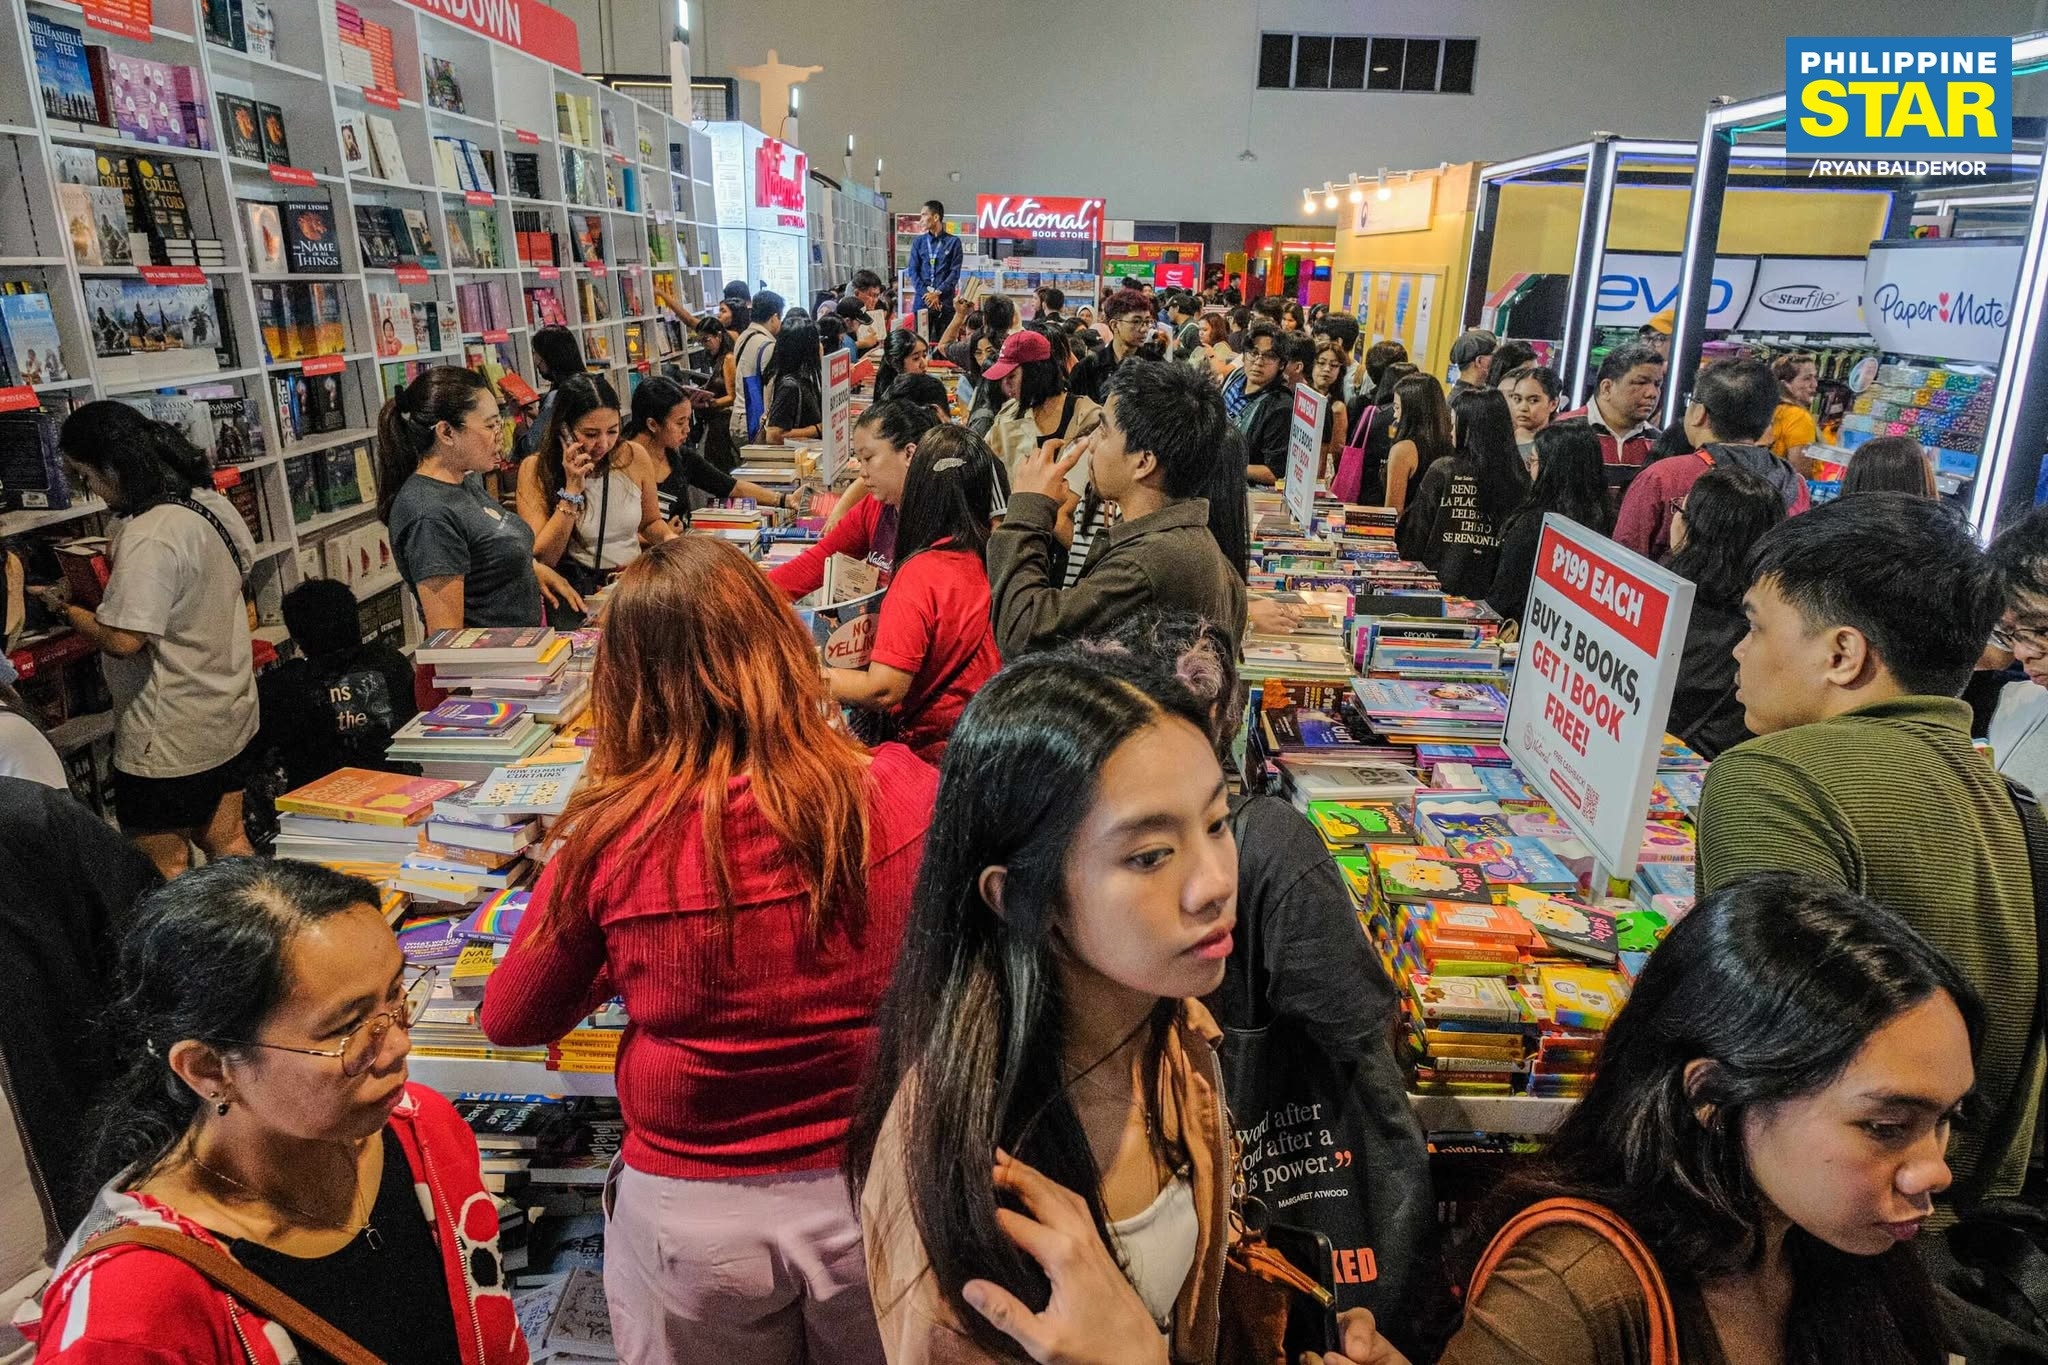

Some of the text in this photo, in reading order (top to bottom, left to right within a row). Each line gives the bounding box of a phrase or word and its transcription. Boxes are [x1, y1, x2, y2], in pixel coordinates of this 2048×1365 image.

[48, 30, 83, 47] ANIELLE
[980, 197, 1093, 229] National
[1061, 231, 1090, 239] STORE
[1874, 283, 2008, 329] Paper Mate
[1440, 497, 1452, 507] LA
[1442, 532, 1454, 543] SE
[1590, 567, 1645, 628] EACH
[852, 619, 872, 638] NO
[1530, 597, 1640, 716] BUY 3 BOOKS,
[1532, 640, 1626, 743] GET 1 BOOK
[336, 710, 368, 731] the
[1544, 692, 1590, 757] FREE!
[1274, 1102, 1322, 1128] after
[1234, 1128, 1334, 1172] ord after a
[1248, 1171, 1258, 1194] is
[1278, 1188, 1349, 1209] MARGARET ATWOOD
